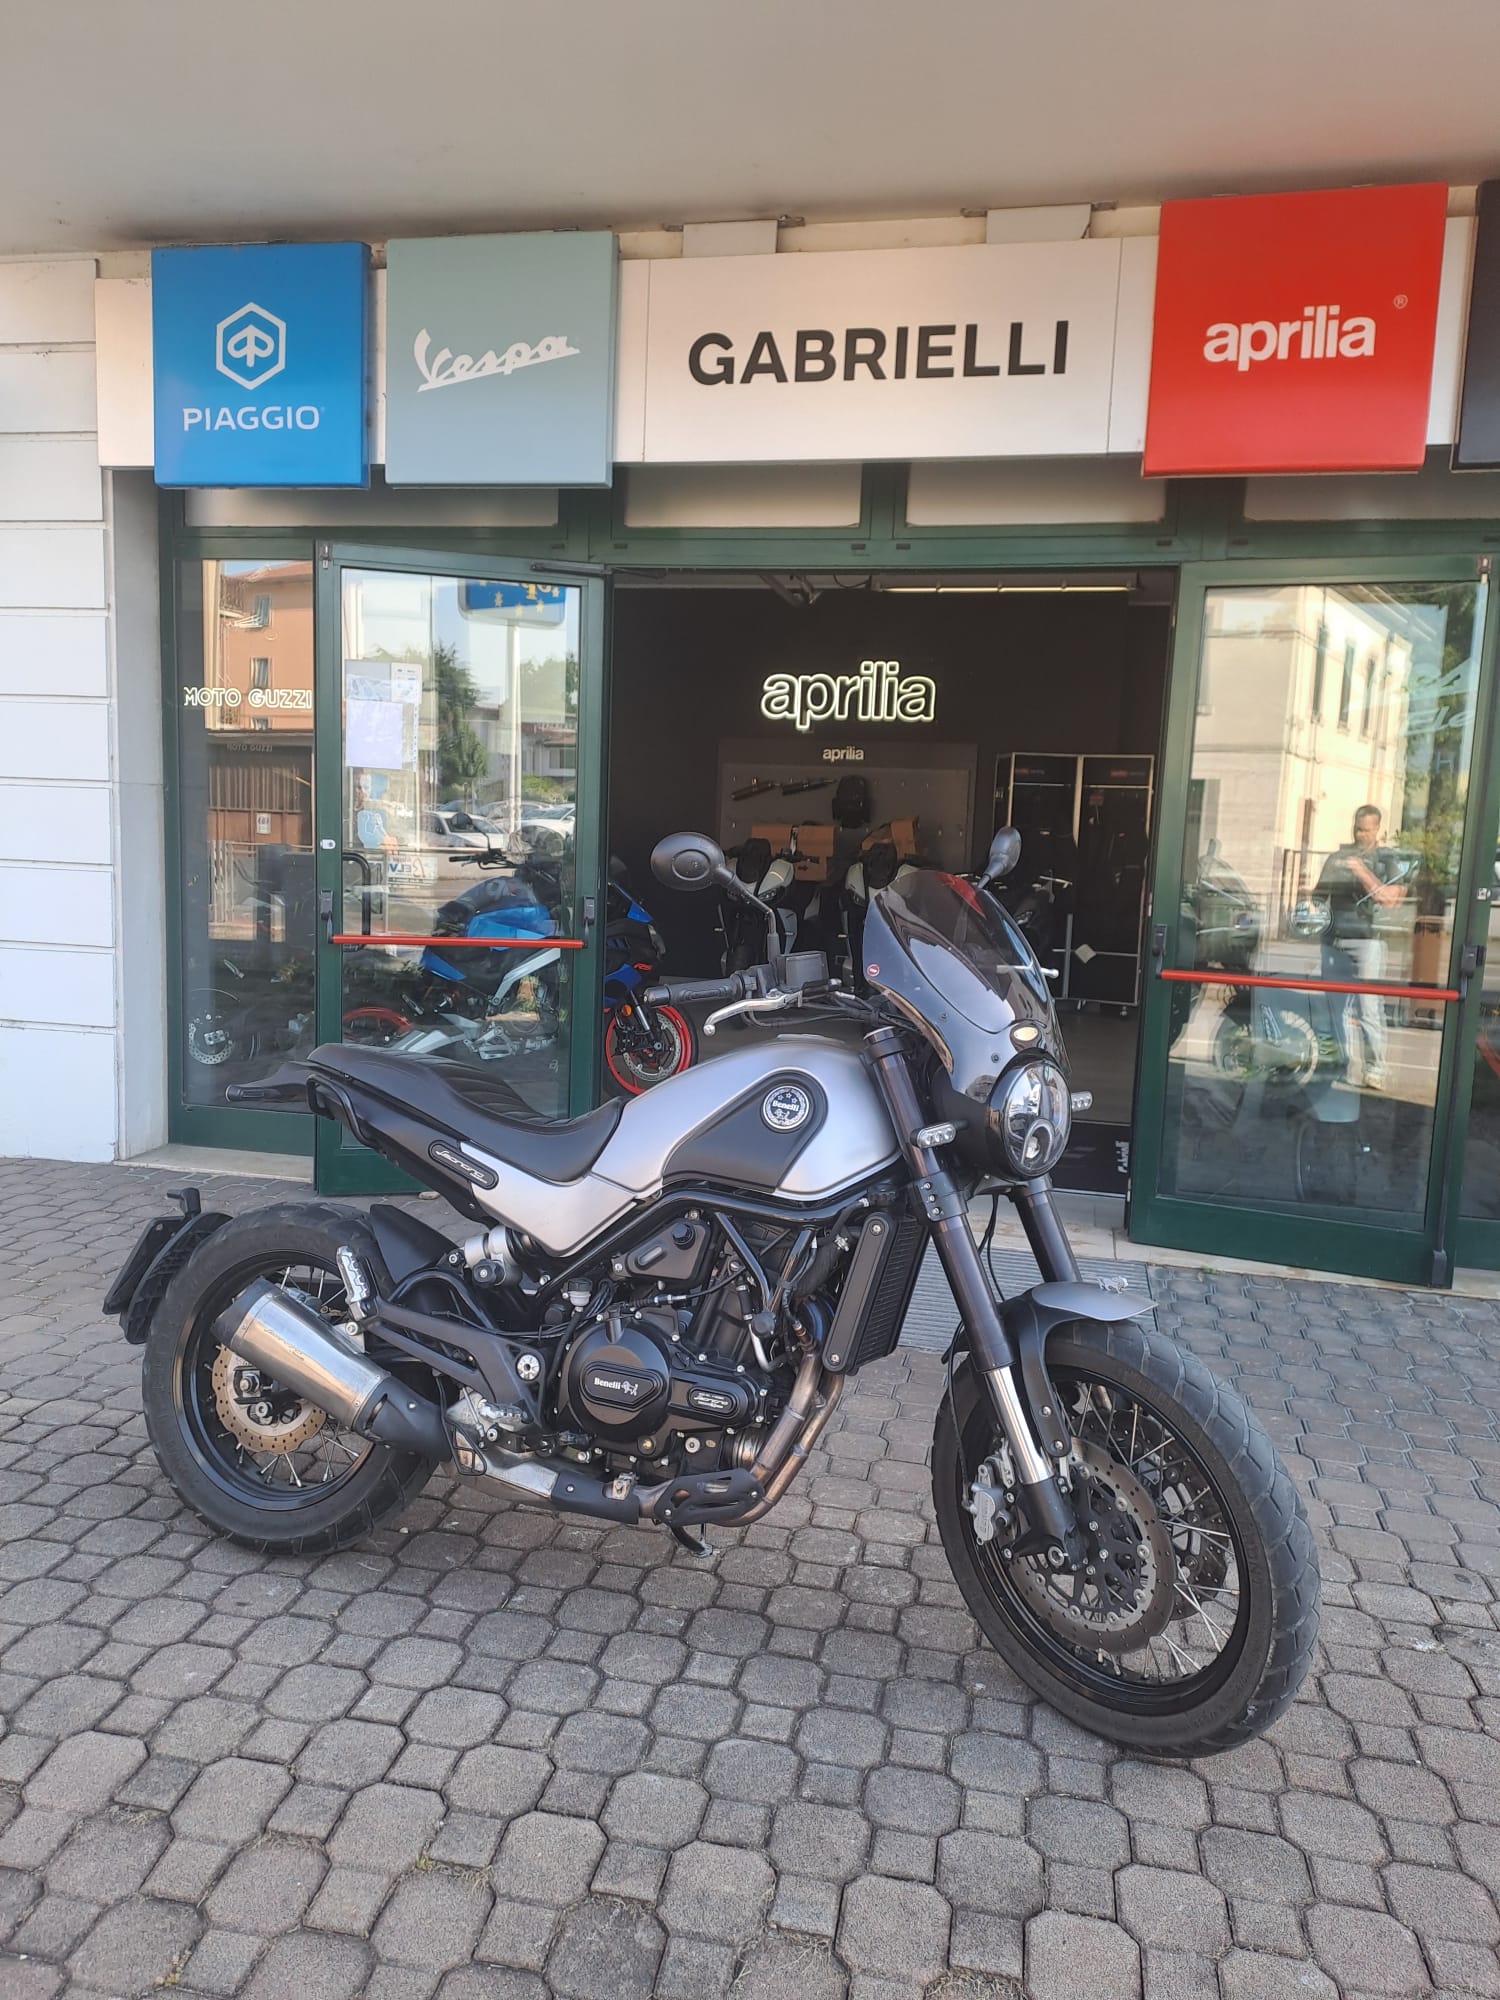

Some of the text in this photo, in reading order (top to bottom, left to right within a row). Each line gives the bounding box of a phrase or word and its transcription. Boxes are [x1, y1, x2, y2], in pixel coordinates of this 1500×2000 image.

[413, 328, 581, 393] Vespa
[688, 320, 1069, 386] GABRIELLI
[1203, 304, 1376, 372] aprilia
[182, 405, 320, 432] PIAGGIO
[183, 686, 313, 709] MOTO GUZZI
[760, 660, 936, 731] aprilia
[822, 745, 865, 763] aprilia
[594, 1377, 621, 1390] Benelli
